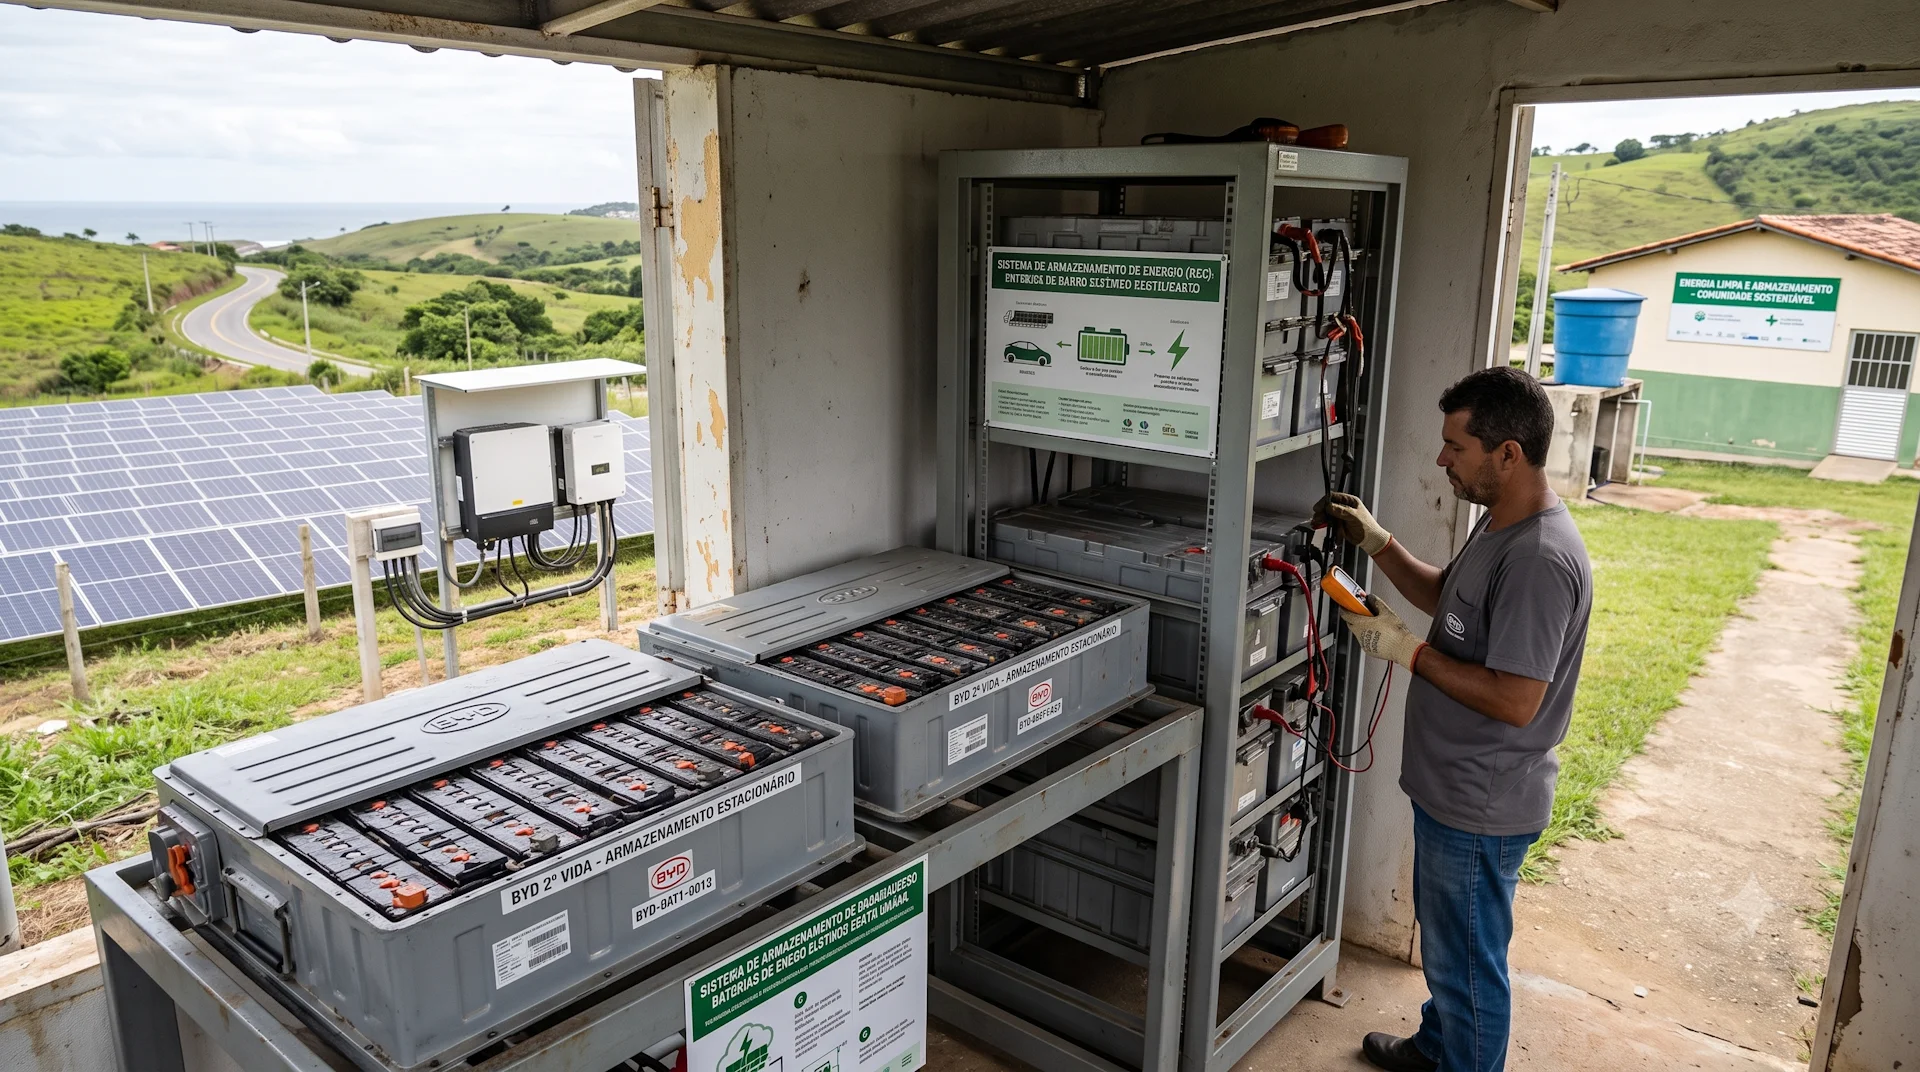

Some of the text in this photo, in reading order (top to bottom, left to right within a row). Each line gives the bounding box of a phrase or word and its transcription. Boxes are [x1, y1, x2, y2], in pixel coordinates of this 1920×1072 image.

[997, 259, 1032, 271] SISTEMA
[1034, 261, 1046, 271] DE
[1047, 262, 1127, 275] ARMAZENAMENTO
[1128, 264, 1141, 276] DE
[1045, 275, 1057, 286] DE
[1058, 276, 1088, 287] BARRO
[1679, 278, 1715, 288] ENERGIA
[1716, 279, 1743, 290] LIMPA
[1744, 280, 1751, 290] E
[1696, 289, 1753, 301] COMUNIDADE
[954, 690, 970, 706] BYD
[981, 677, 1000, 693] VIDA
[1005, 646, 1070, 683] ARMAZENAMENTO
[1070, 624, 1117, 653] ESTACIONÁRIO
[511, 882, 539, 905] BYD
[560, 859, 593, 883] VIDA
[605, 806, 714, 865] ARMAZENAMENTO
[717, 770, 795, 815] ESTACIONÁRIO
[656, 862, 686, 886] BYD
[746, 955, 760, 974] DE
[761, 911, 843, 966] ARMAZENAMENTO
[844, 903, 857, 920] DE
[761, 964, 775, 982] DE
[775, 946, 807, 973] ENEGO
